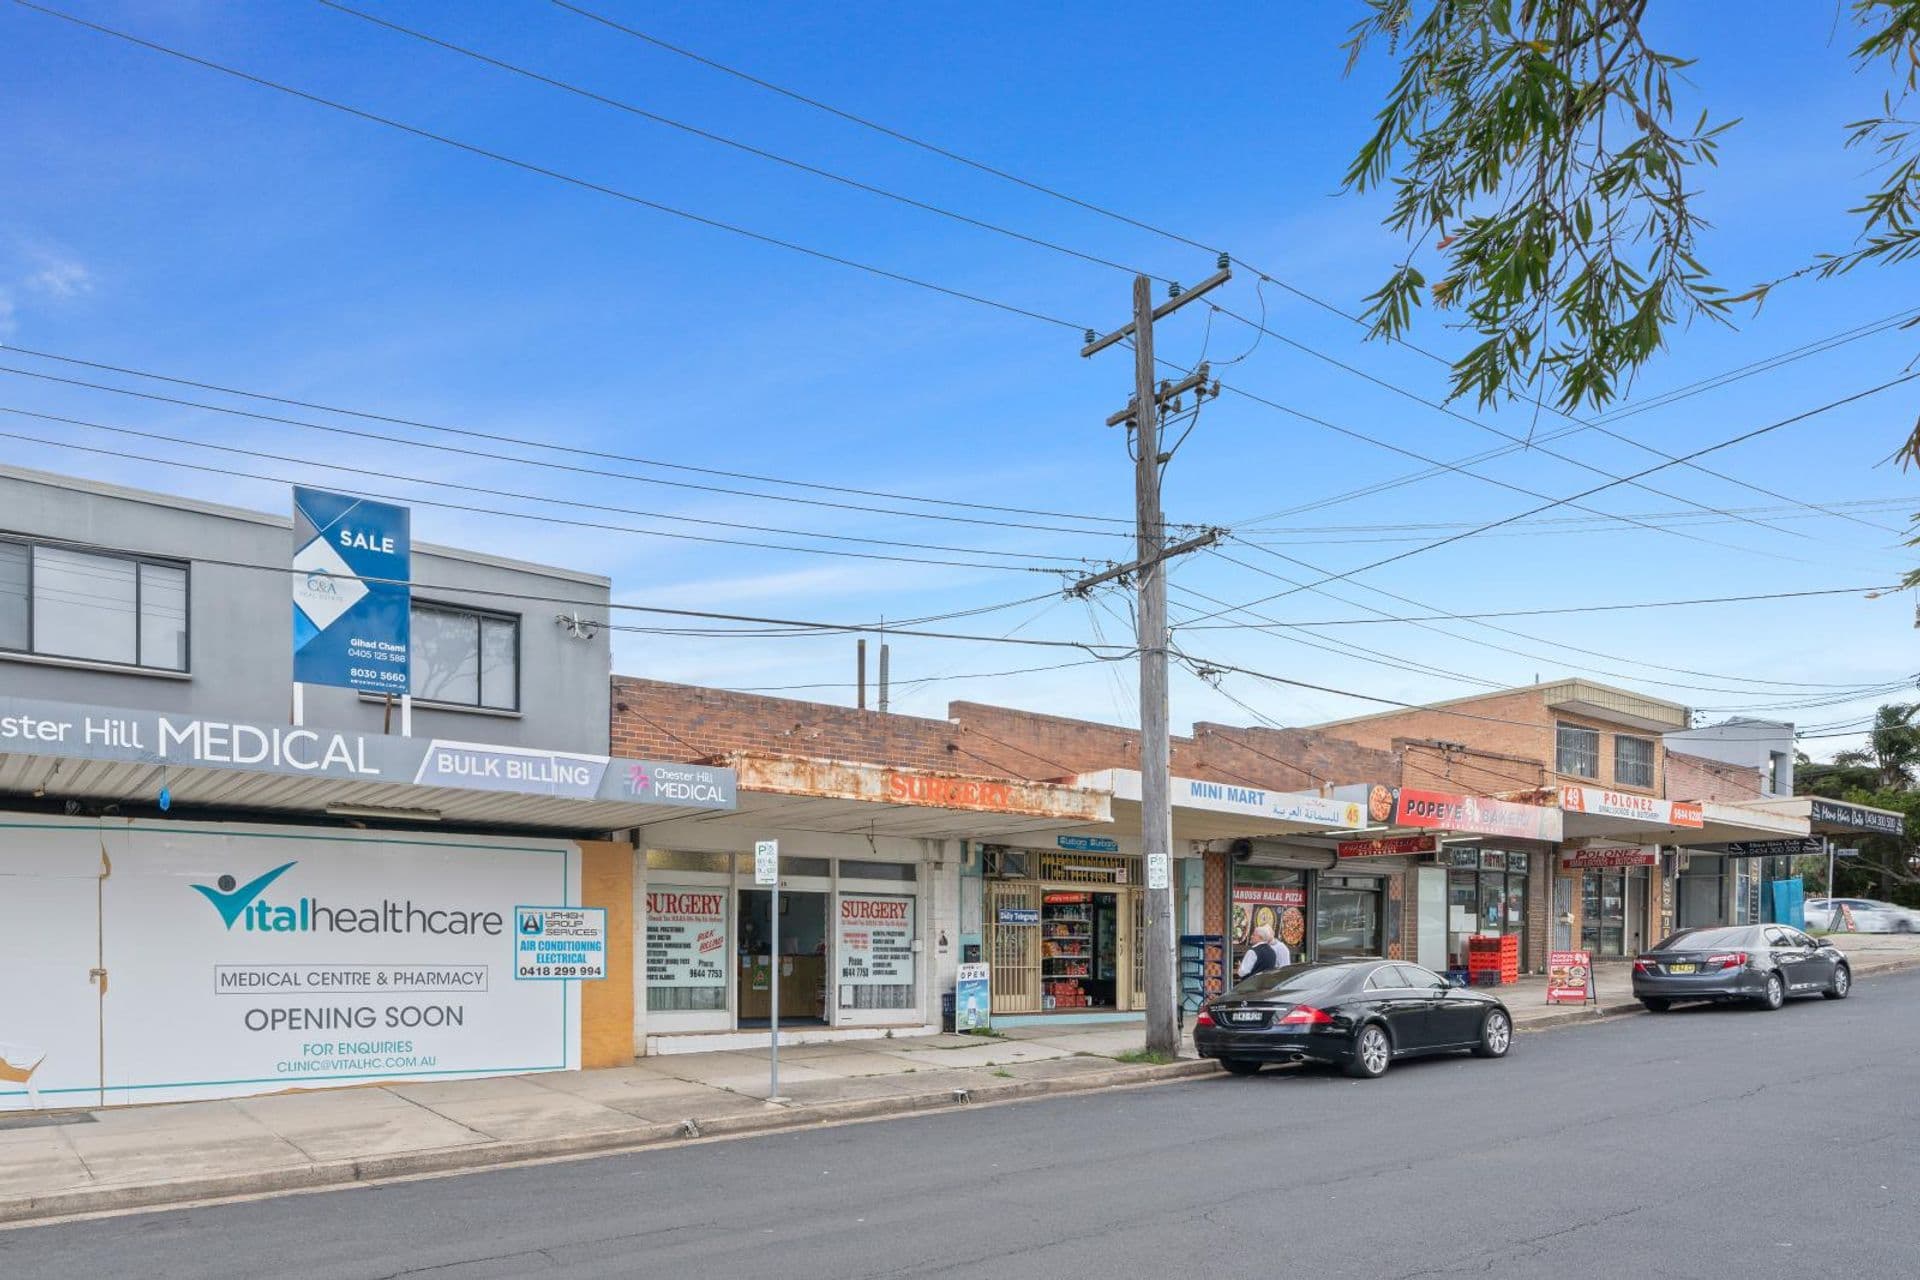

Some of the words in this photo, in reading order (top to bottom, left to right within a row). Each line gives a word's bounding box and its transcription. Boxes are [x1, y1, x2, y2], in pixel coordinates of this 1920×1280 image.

[340, 530, 395, 554] SALE
[347, 648, 372, 659] 0405
[350, 668, 377, 678] 8030
[380, 671, 406, 682] 5660
[85, 716, 145, 750] Hill
[158, 717, 380, 775] MEDICAL
[437, 753, 501, 778] BULK
[506, 759, 590, 786] BILLING
[654, 767, 695, 781] Chester
[696, 771, 714, 784] Hill
[654, 781, 727, 802] MEDICAL
[889, 772, 1014, 808] SURGERY
[1190, 782, 1222, 801] MINI
[1227, 787, 1265, 806] MART
[1406, 799, 1463, 821] POPEYE
[1603, 793, 1653, 812] POLONEZ
[1575, 848, 1641, 859] POLONEZ
[647, 893, 723, 915] SURGERY
[1285, 892, 1302, 902] PIZZA
[841, 900, 909, 919] SURGERY
[544, 920, 584, 928] GROUP
[544, 928, 598, 936] SERVICES
[520, 940, 537, 951] AIR
[538, 940, 602, 952] CONDITIONING
[536, 953, 587, 964] ELECTRICAL
[220, 972, 302, 987] MEDICAL
[306, 971, 371, 986] CENTRE
[376, 971, 388, 986] &
[393, 971, 484, 986] PHARMACY
[519, 966, 551, 976] 0418
[554, 966, 577, 976] 299
[580, 966, 602, 976] 994
[689, 969, 706, 978] 9644
[707, 969, 723, 978] 7753
[960, 970, 985, 979] OPEN
[244, 1006, 377, 1031] OPENING
[385, 1005, 464, 1028] SOON
[303, 1043, 334, 1056] FOR
[338, 1041, 413, 1055] ENQUIRIES
